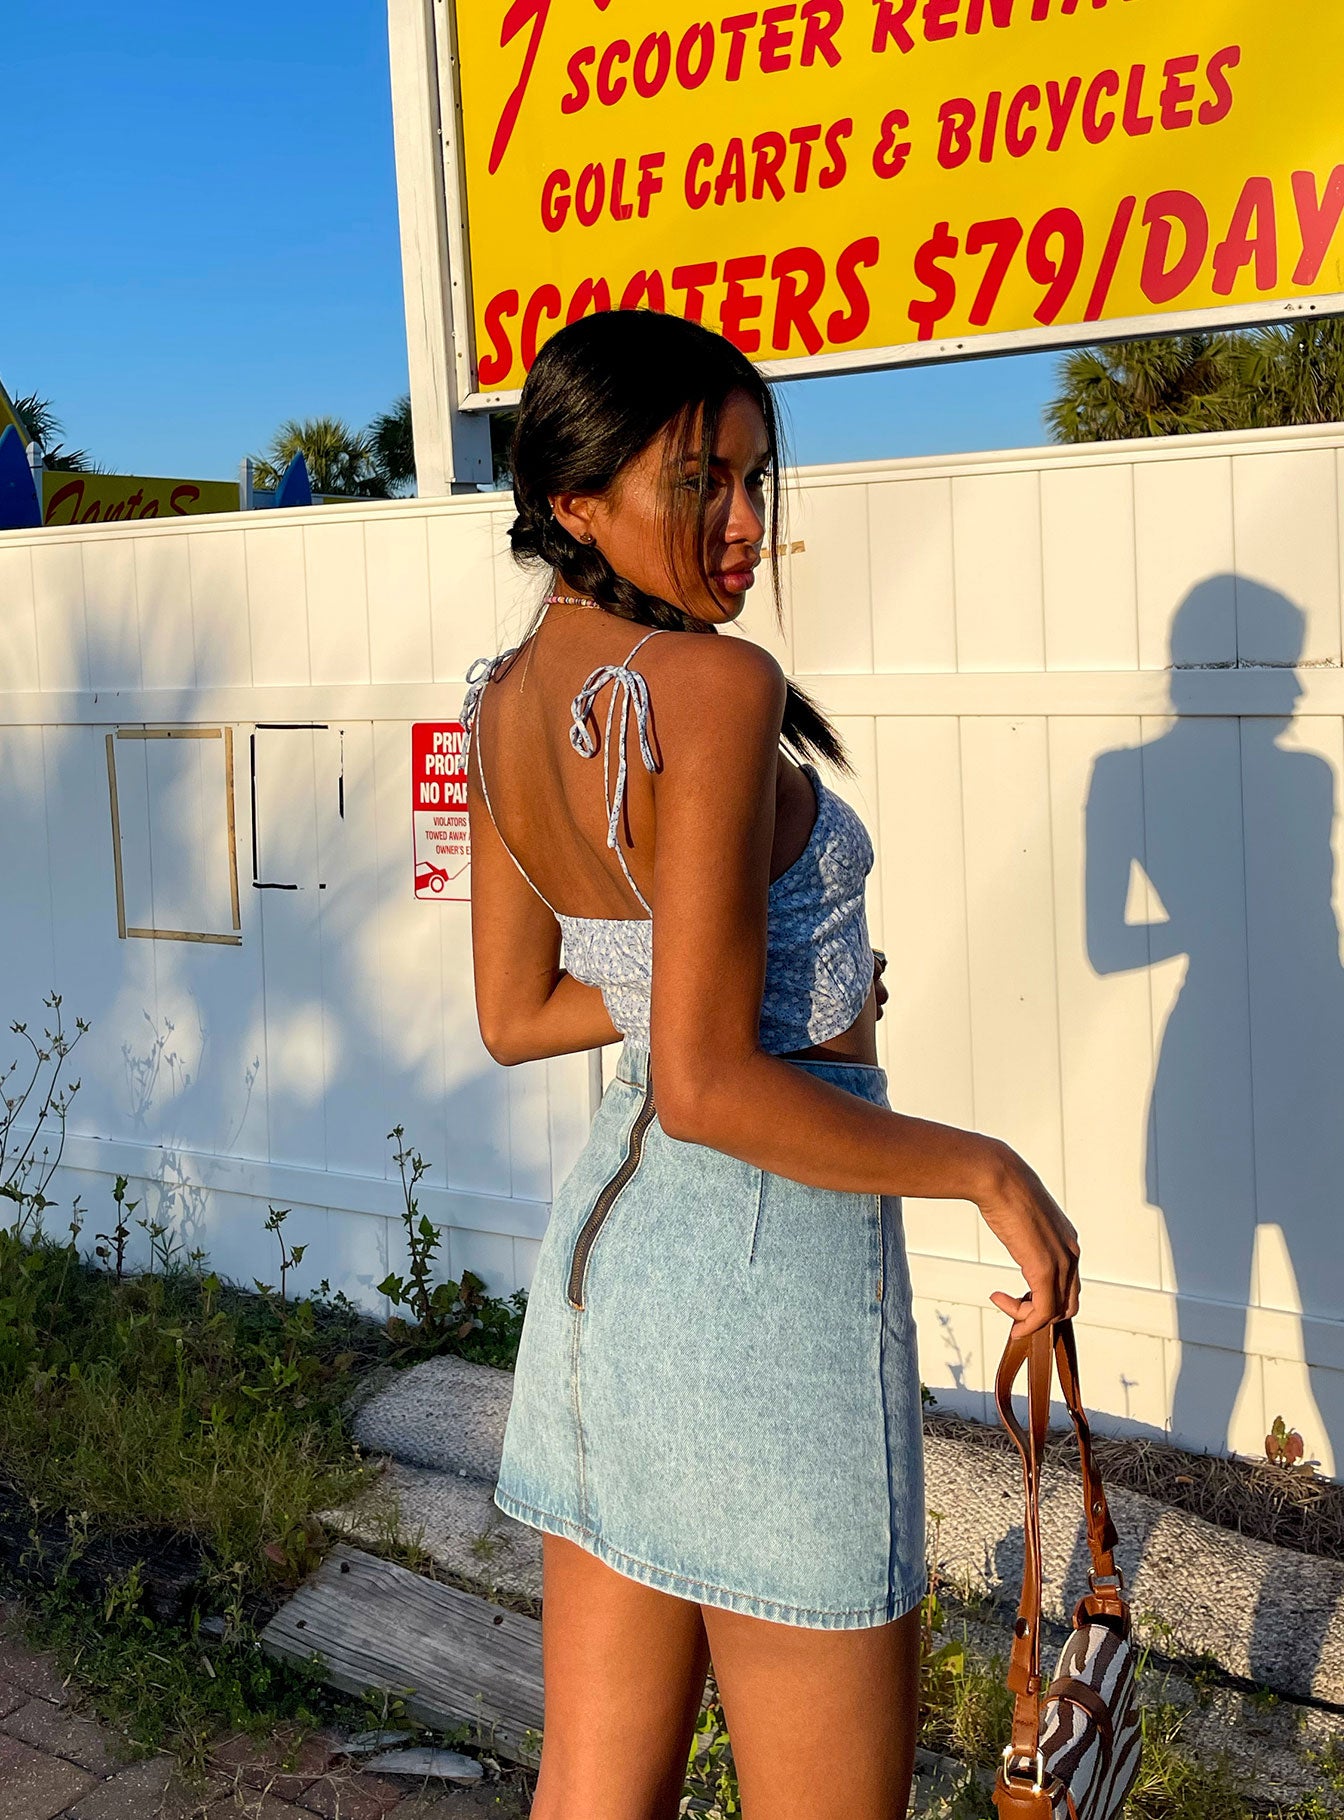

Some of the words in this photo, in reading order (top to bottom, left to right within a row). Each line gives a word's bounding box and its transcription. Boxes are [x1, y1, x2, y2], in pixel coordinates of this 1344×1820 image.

[561, 0, 844, 114] SCOOTER
[541, 152, 666, 233] GOLF
[685, 118, 853, 209] CARTS
[873, 109, 912, 180] &
[938, 46, 1241, 169] BICYCLES
[908, 164, 1344, 341] $79/DAY
[433, 732, 470, 753] PRIV
[425, 754, 469, 775] PROP
[420, 782, 440, 804] NO
[433, 817, 467, 827] VIOLATORS
[425, 831, 447, 841] TOWED
[449, 831, 467, 841] AWAY
[435, 845, 464, 855] OWNER'S
